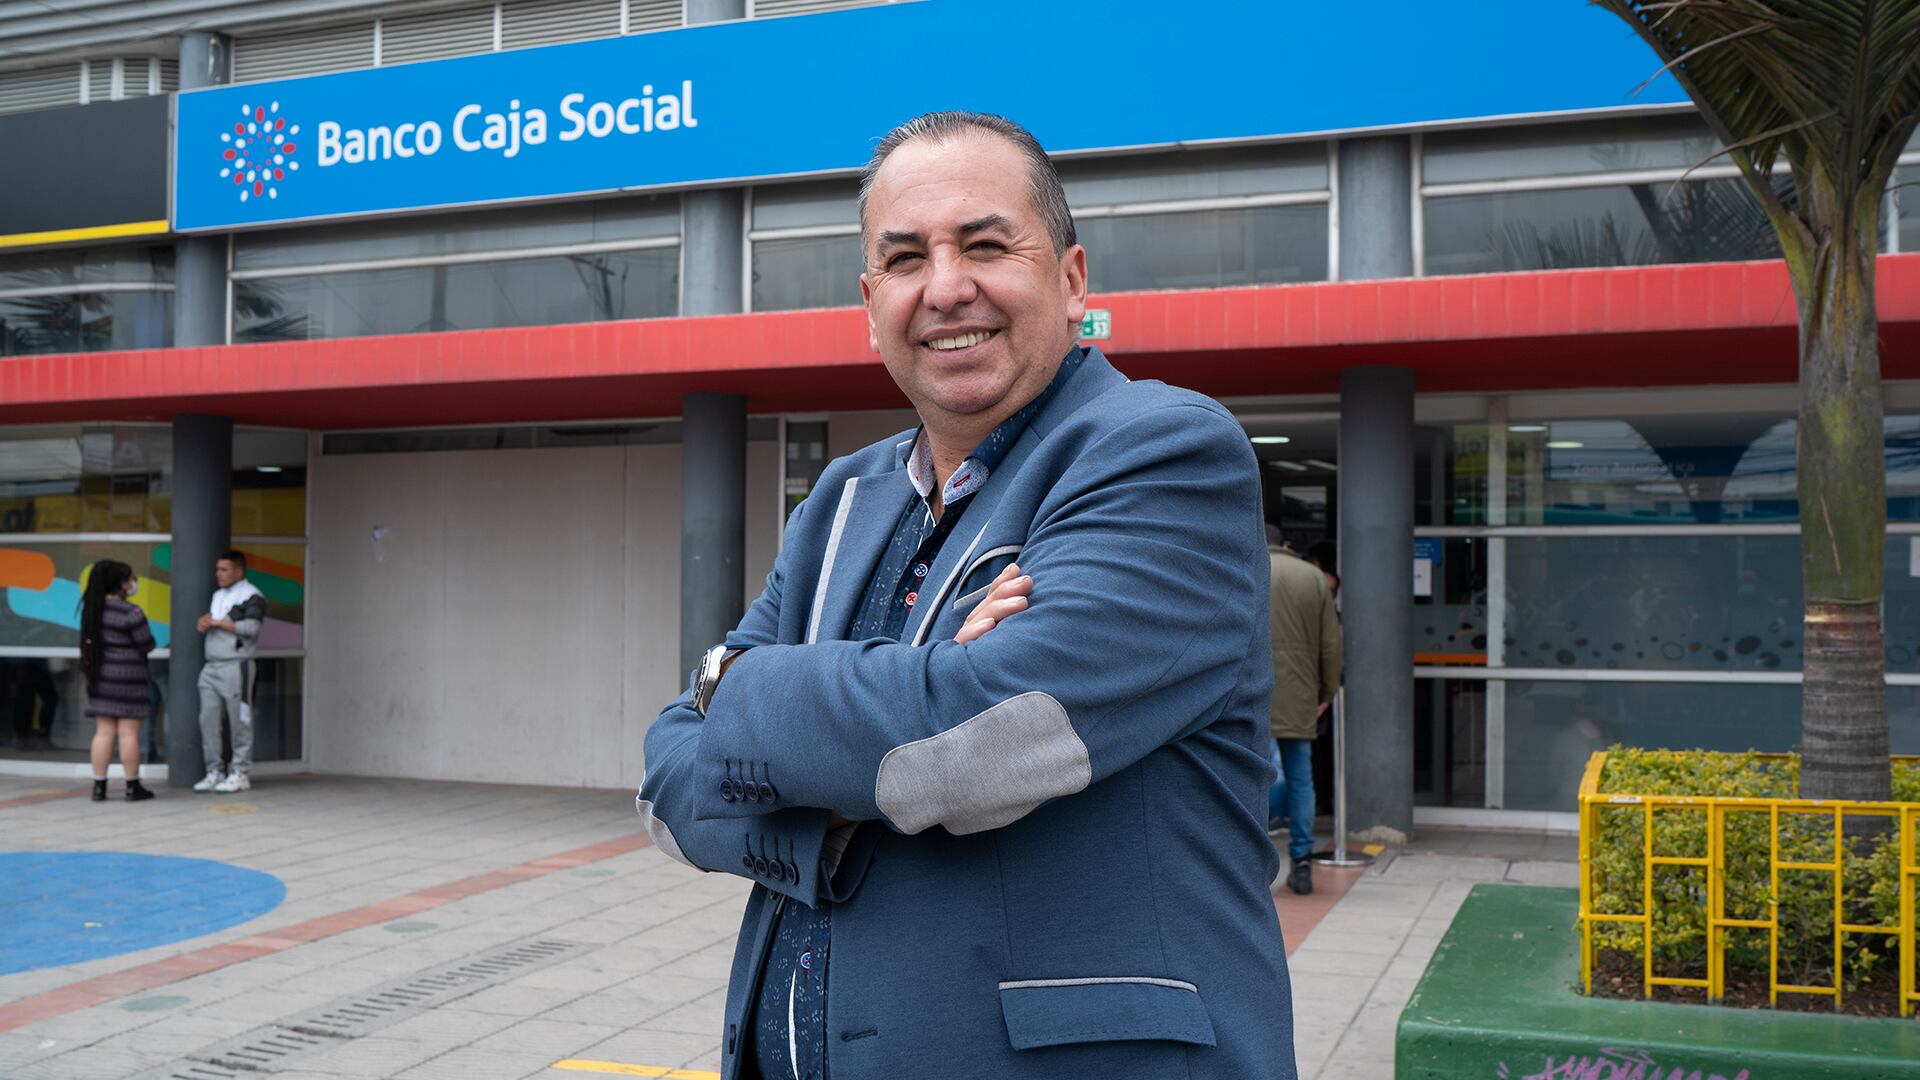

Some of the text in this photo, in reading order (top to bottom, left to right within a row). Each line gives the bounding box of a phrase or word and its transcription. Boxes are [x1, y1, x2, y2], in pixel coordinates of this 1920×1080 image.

[318, 80, 697, 166] Banco Caja Social
